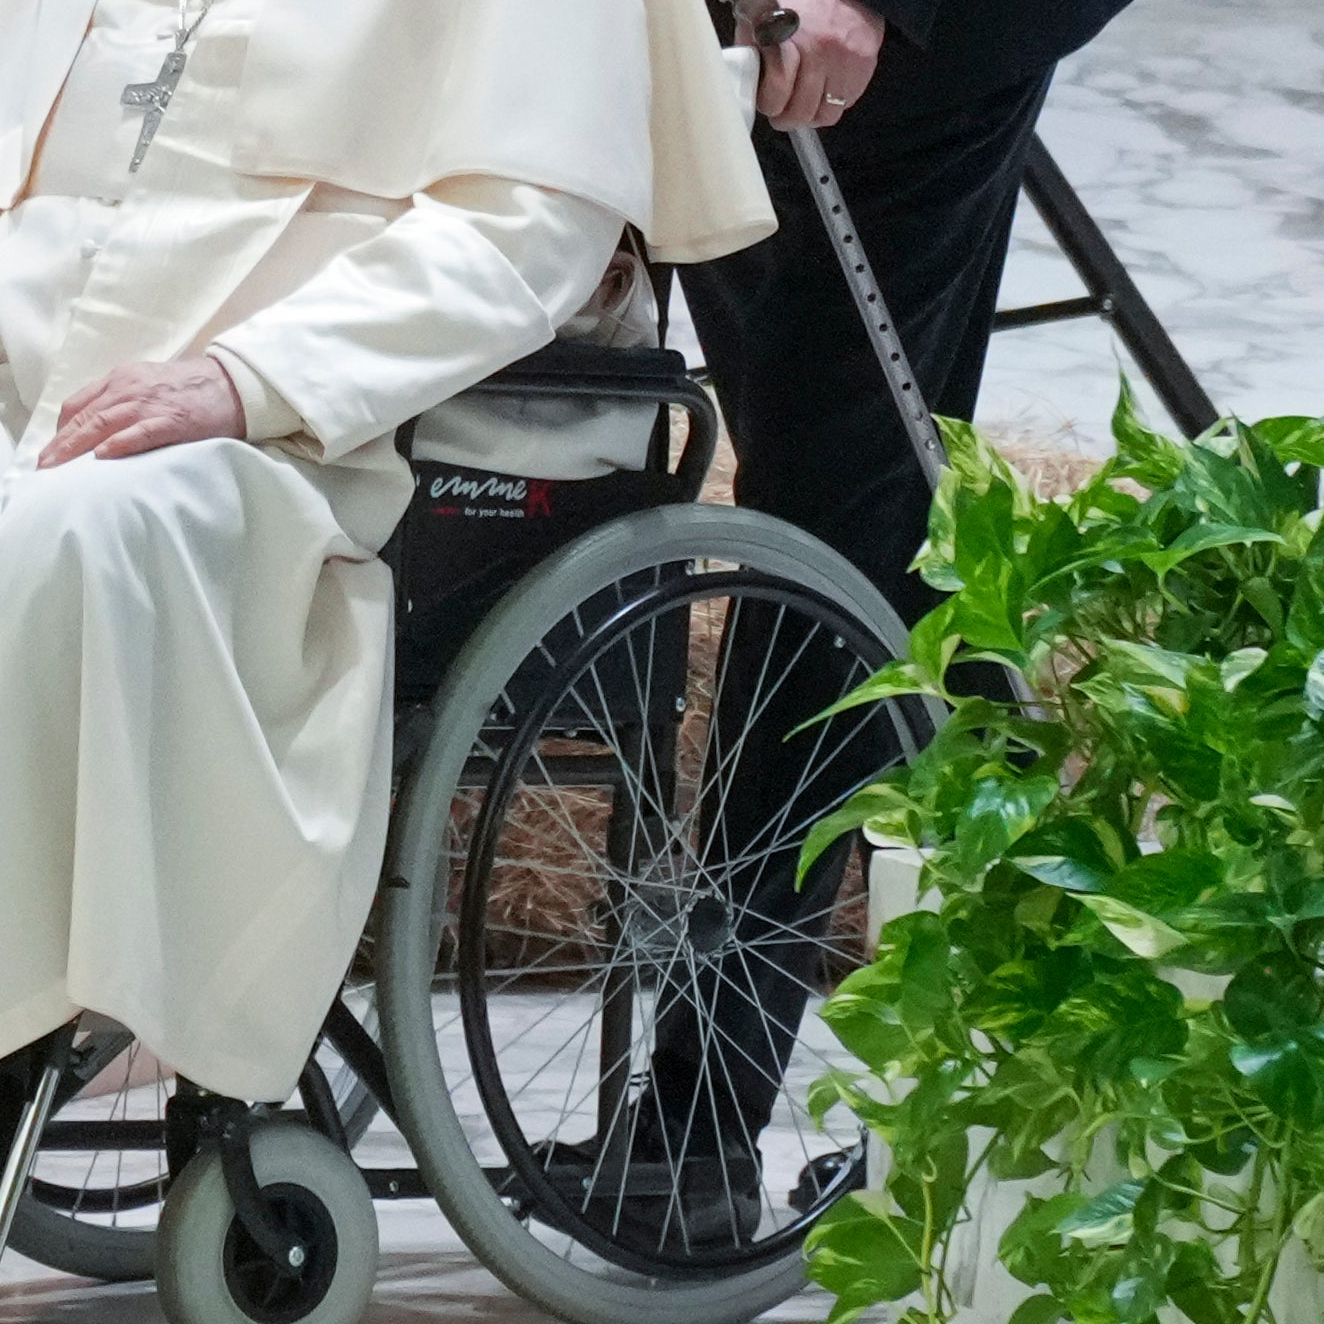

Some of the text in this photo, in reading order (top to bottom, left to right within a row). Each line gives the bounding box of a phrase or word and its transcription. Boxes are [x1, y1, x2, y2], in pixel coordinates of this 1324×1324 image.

[464, 507, 476, 516] for
[479, 509, 496, 517] your
[499, 508, 525, 518] health
